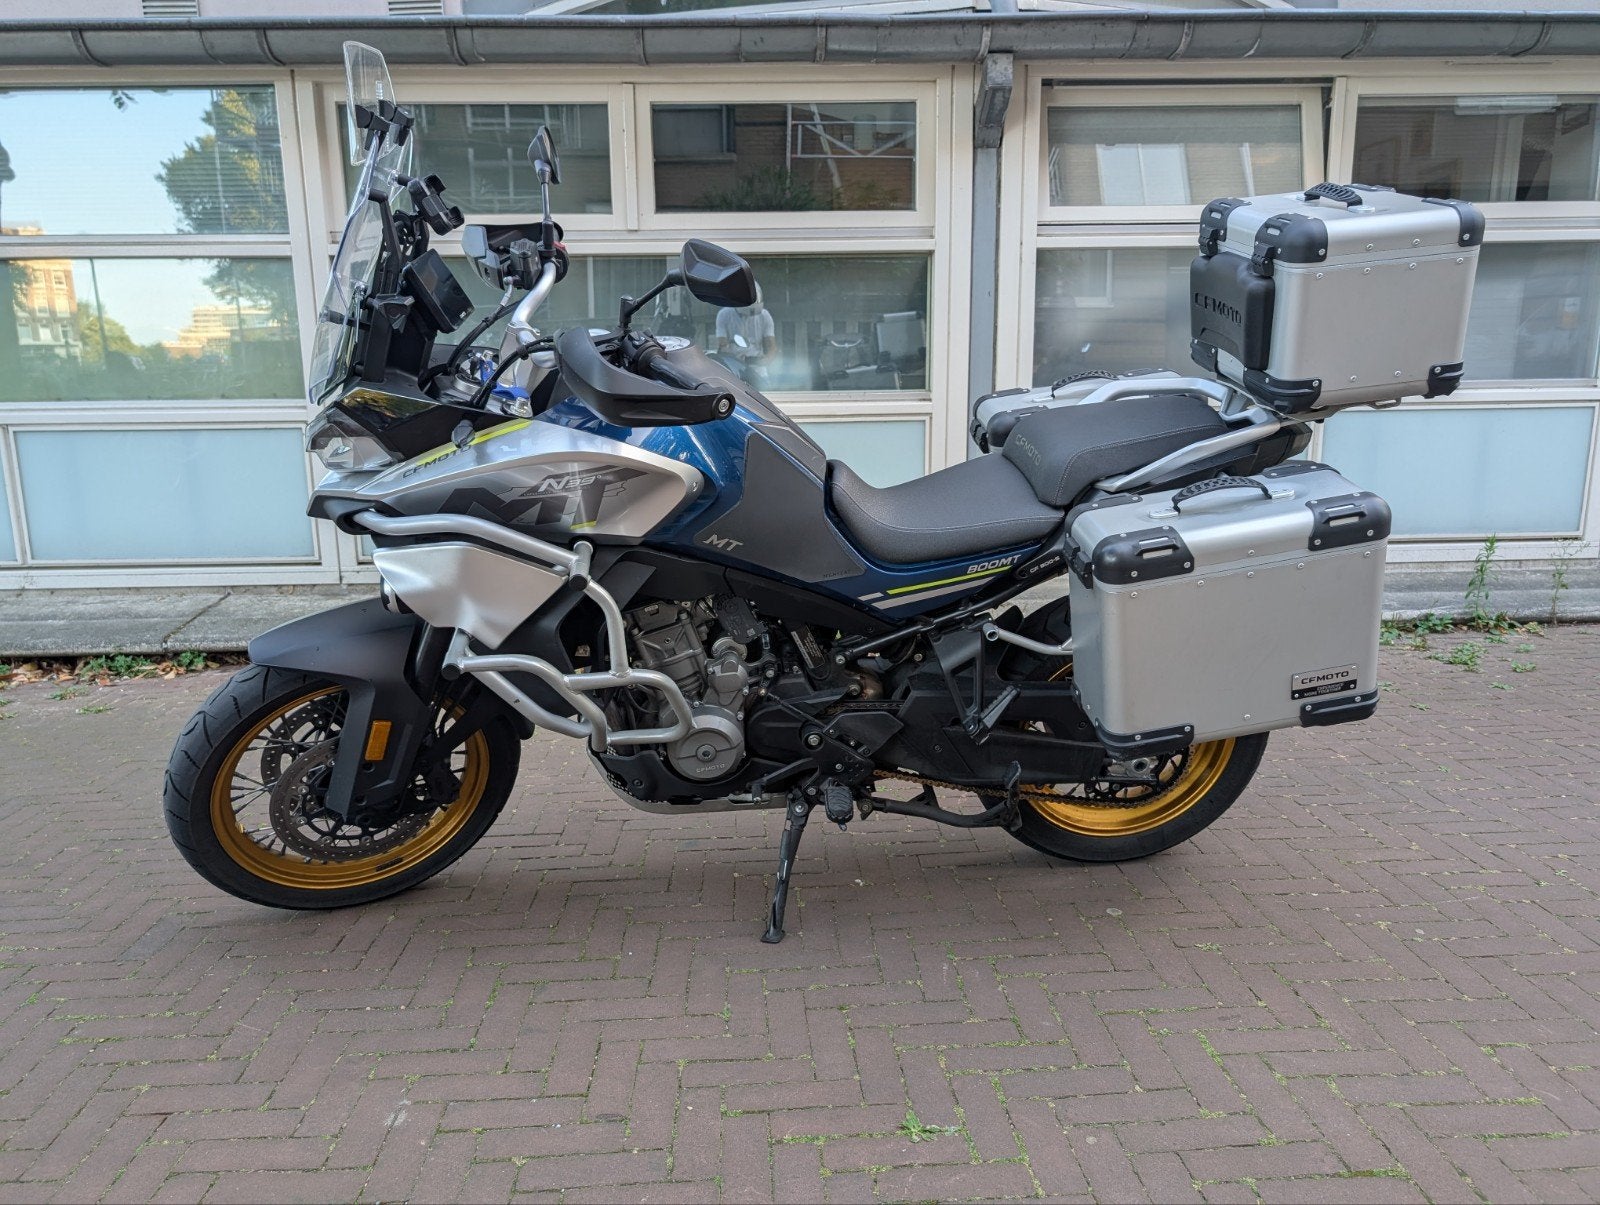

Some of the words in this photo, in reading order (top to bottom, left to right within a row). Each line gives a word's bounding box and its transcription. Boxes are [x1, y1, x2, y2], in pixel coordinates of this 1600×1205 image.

[1194, 292, 1242, 325] CFMOTO
[1015, 433, 1041, 466] CFMOTO
[702, 534, 744, 551] MT
[967, 555, 1021, 574] 800MT
[1301, 671, 1349, 684] CFMOTO
